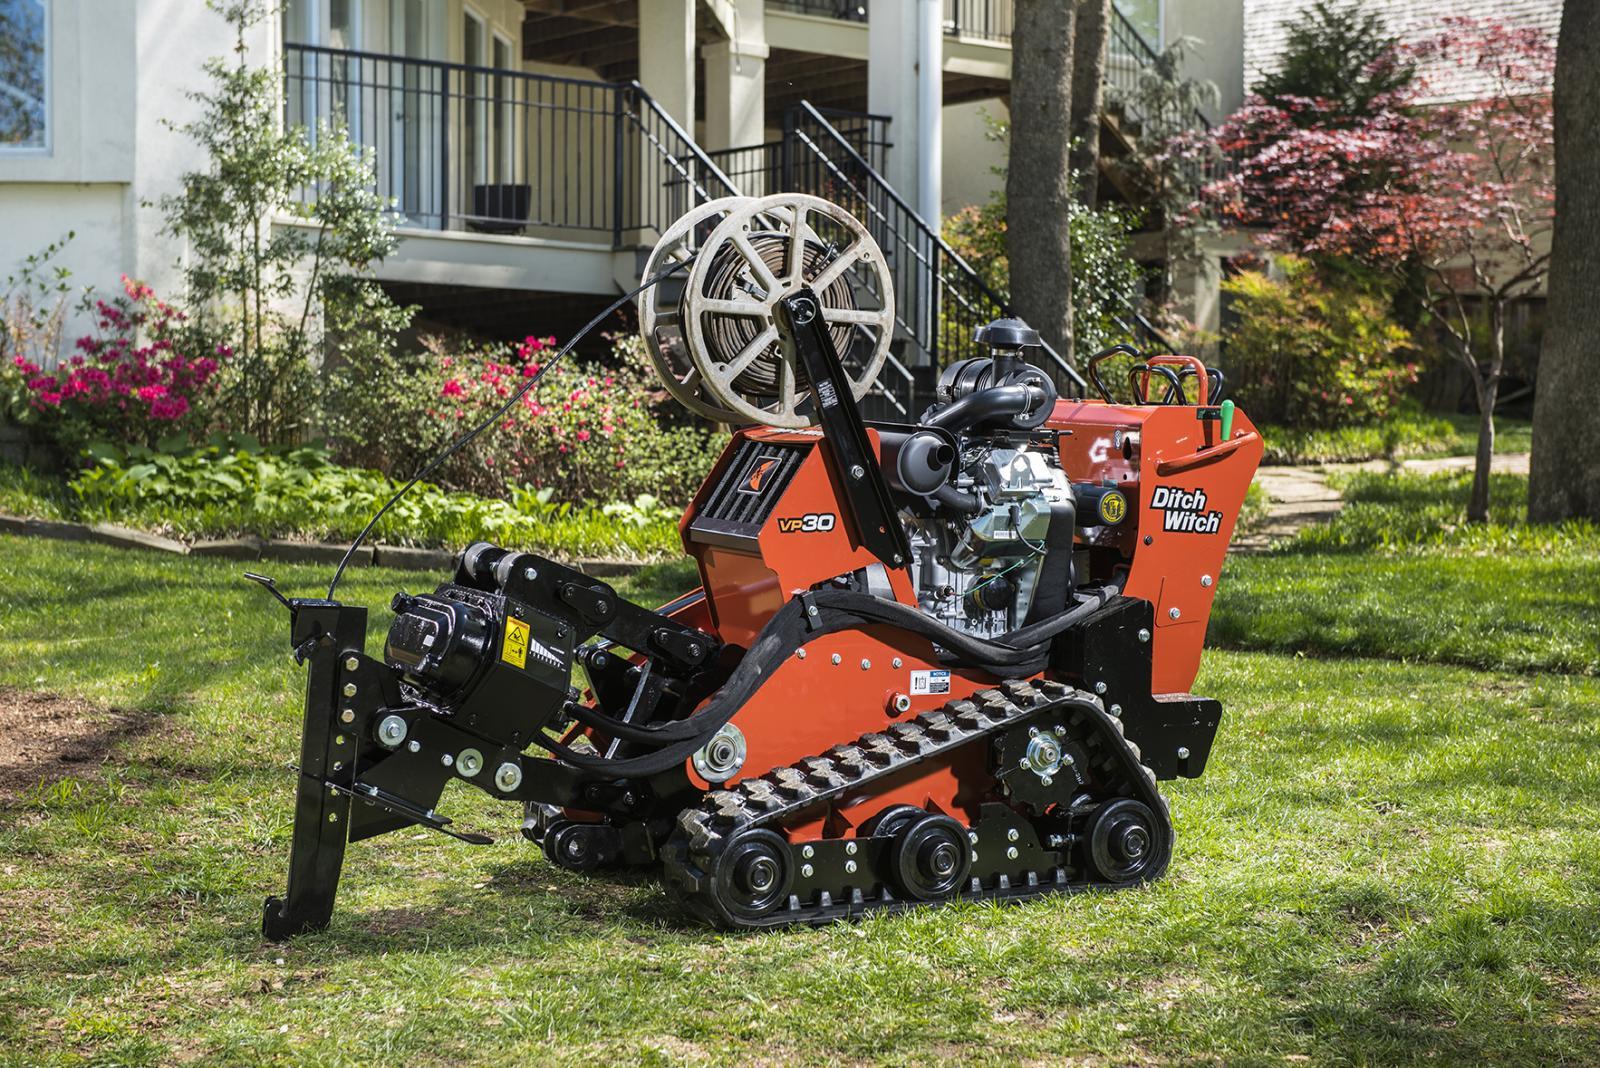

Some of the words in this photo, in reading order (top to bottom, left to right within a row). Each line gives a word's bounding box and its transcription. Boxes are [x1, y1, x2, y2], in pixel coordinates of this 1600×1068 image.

[1151, 487, 1207, 510] Ditch
[778, 513, 835, 532] VP30
[1164, 510, 1220, 532] Witch
